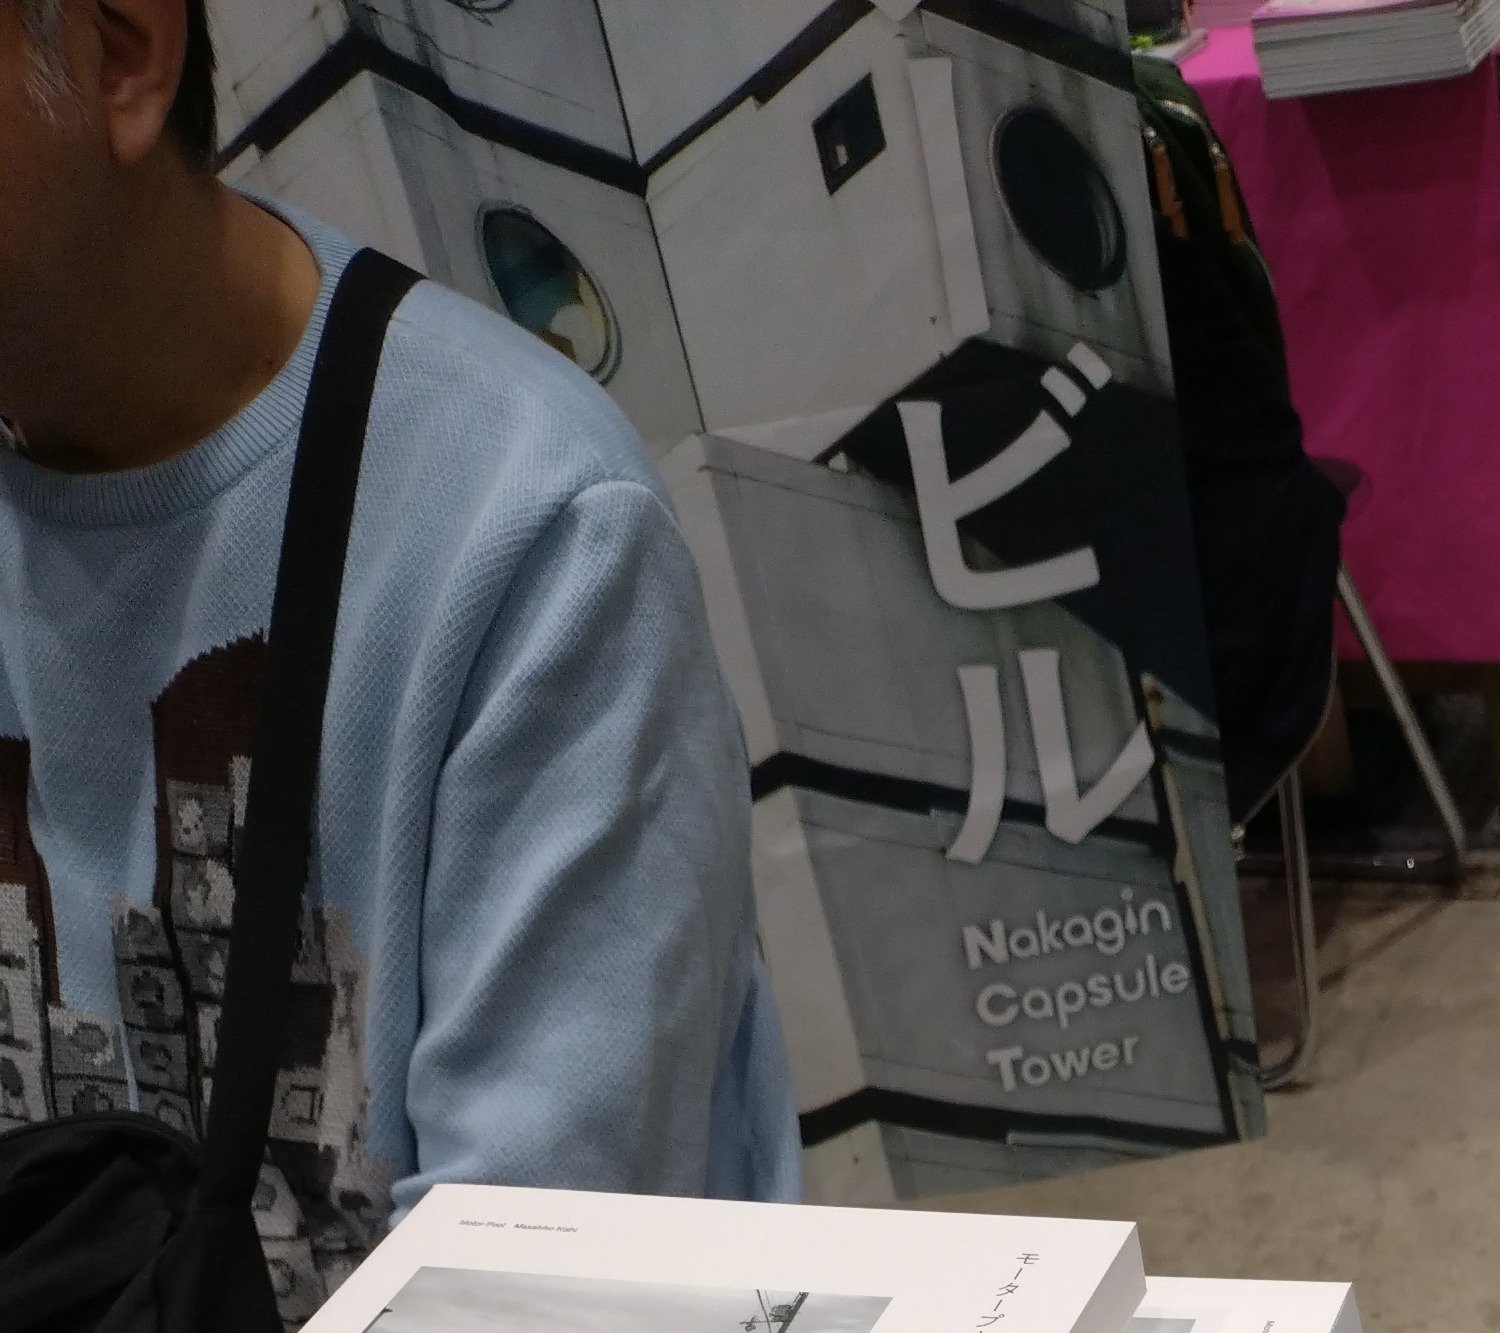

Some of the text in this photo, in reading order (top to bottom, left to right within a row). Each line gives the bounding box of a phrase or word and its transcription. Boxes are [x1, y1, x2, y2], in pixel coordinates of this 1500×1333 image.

[897, 341, 1156, 864] ビル
[962, 886, 1173, 970] Nakagin
[977, 952, 1191, 1030] Capsule
[987, 1032, 1142, 1093] Tower
